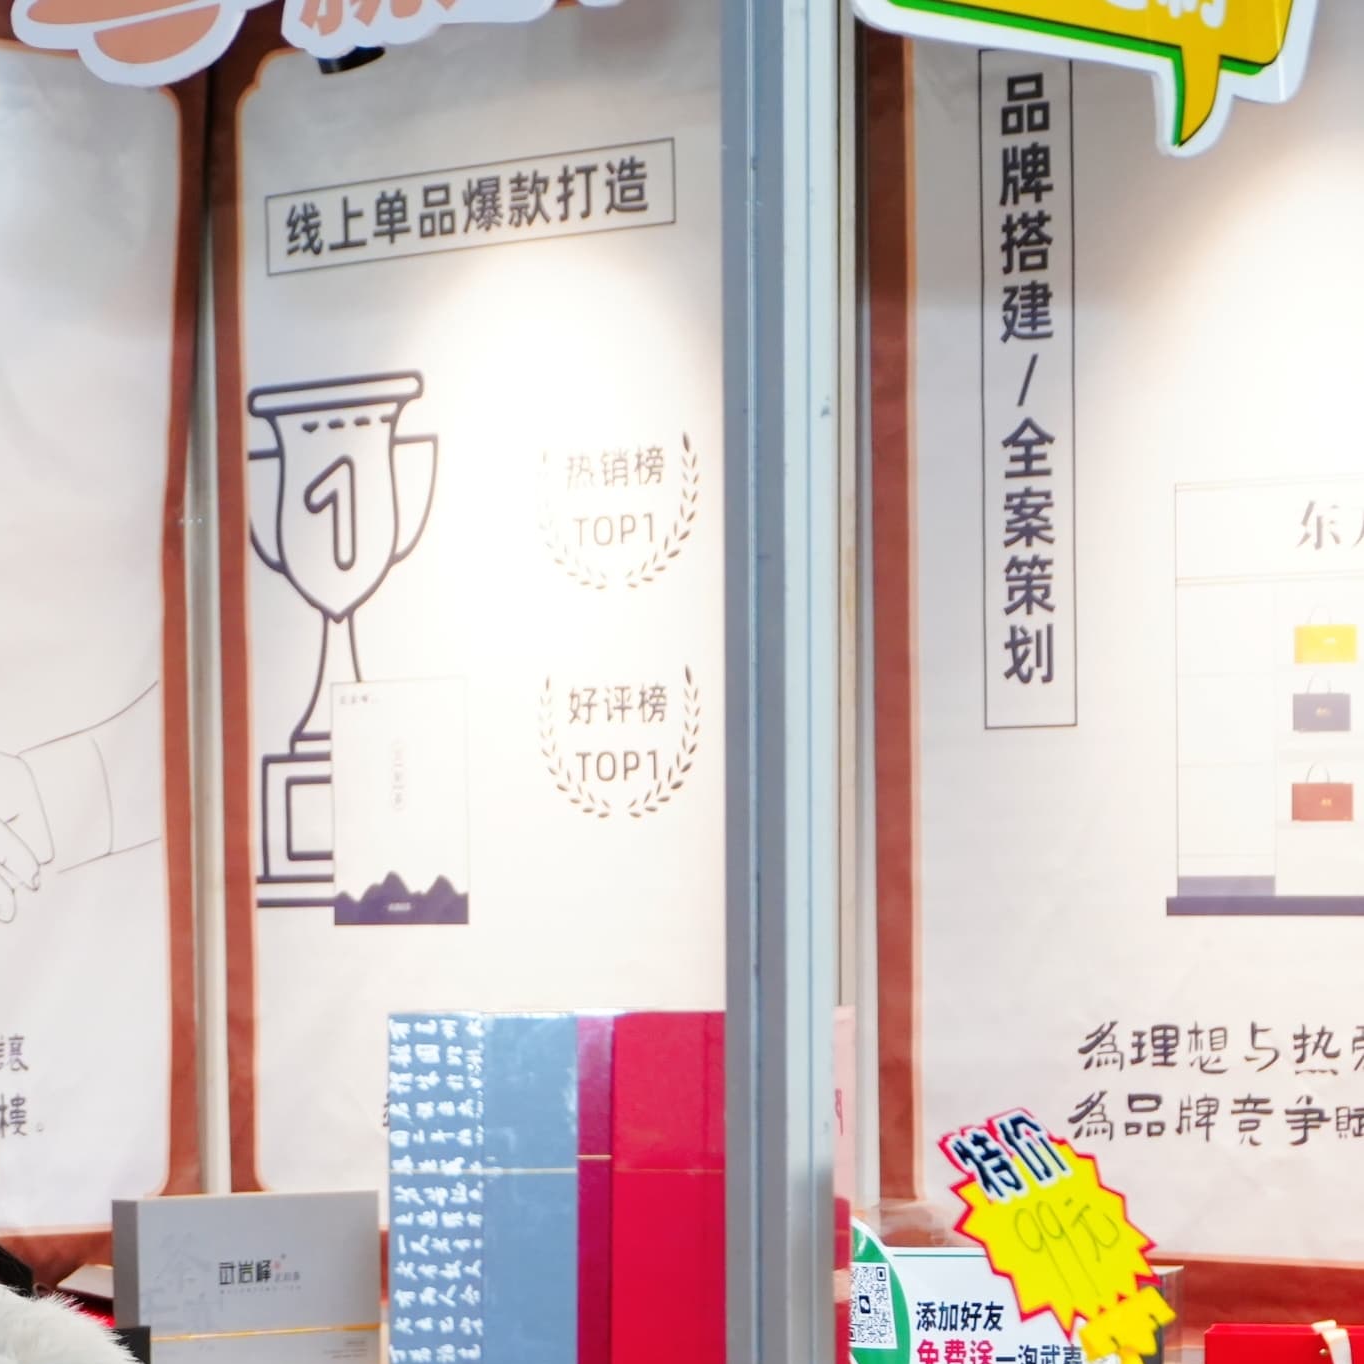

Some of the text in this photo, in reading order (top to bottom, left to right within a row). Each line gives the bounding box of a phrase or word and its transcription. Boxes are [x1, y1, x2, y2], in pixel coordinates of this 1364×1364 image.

[276, 155, 649, 258] 线上单品爆款打造
[1000, 72, 1055, 684] 品牌搭建/全案策划
[567, 446, 664, 489] 热销榜
[573, 513, 655, 546] TOP1
[1295, 499, 1364, 551] 东
[568, 682, 668, 724] 好评榜
[575, 749, 659, 782] TOP1
[952, 1114, 1068, 1197] 特价
[916, 1301, 1004, 1332] 添加好友
